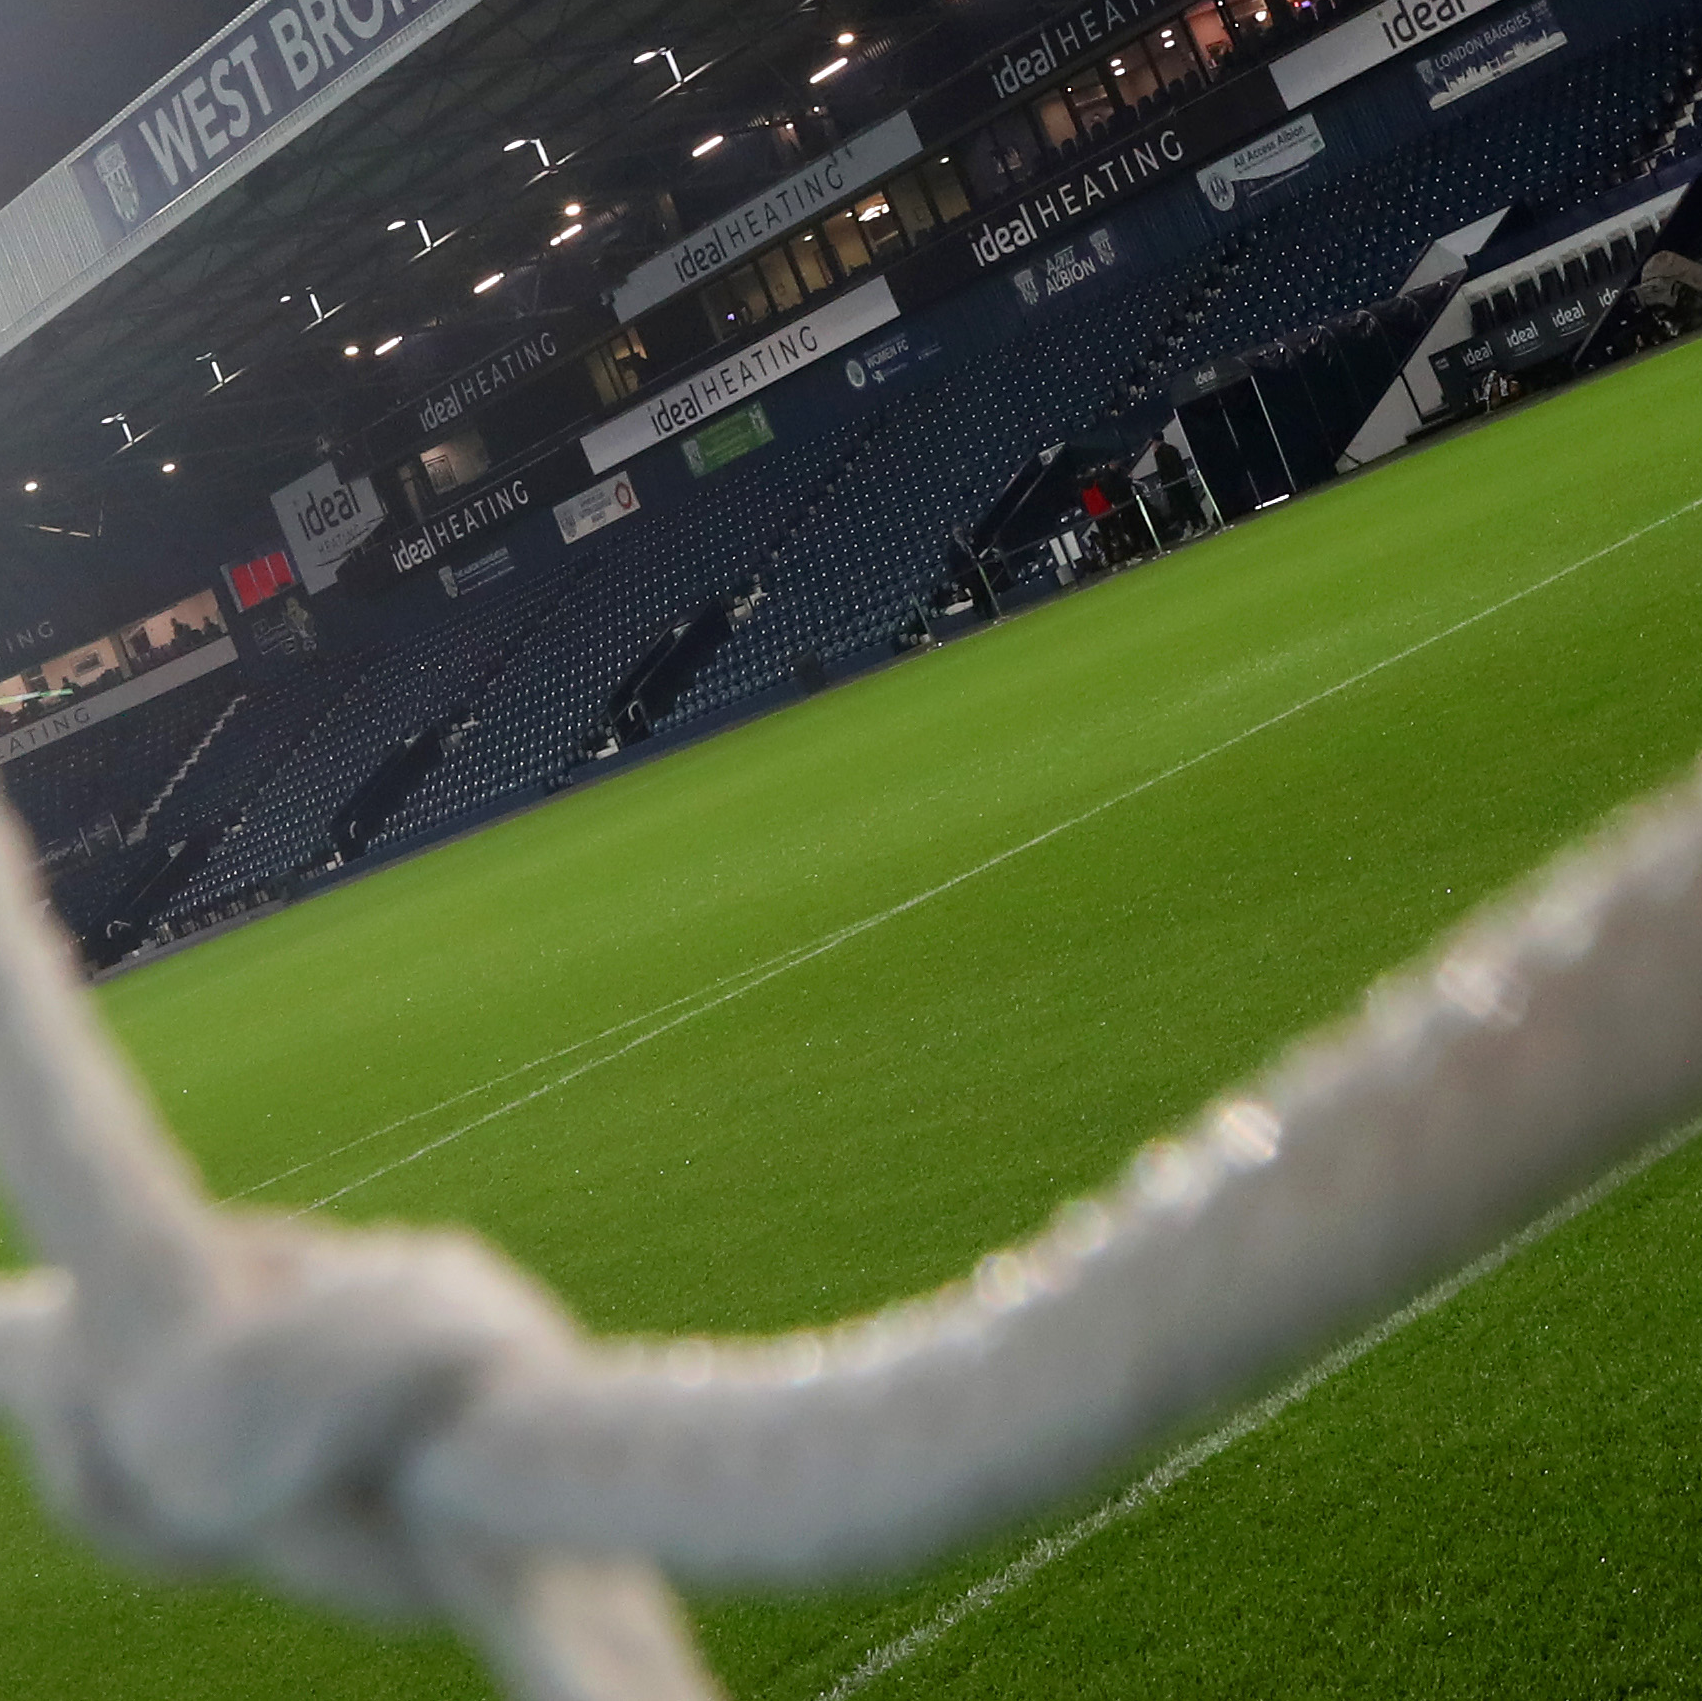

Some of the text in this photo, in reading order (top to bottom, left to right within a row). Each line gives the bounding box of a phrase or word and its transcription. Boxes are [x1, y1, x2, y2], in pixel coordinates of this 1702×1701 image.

[989, 40, 1060, 99] ideal
[1434, 36, 1484, 71] LONDON
[1483, 10, 1532, 45] BAGGIES
[139, 41, 275, 188] WEST
[1233, 155, 1246, 169] All
[1247, 141, 1277, 161] Access
[1277, 125, 1307, 146] Albion
[671, 163, 846, 284] ideal HEATING
[970, 203, 1038, 268] ideal
[1036, 129, 1185, 228] HEATING
[1045, 256, 1097, 296] ALBION
[1505, 320, 1540, 348] ideal
[1552, 300, 1587, 329] ideal
[419, 332, 558, 432] ideal HEATING
[648, 325, 820, 438] ideal HEATING
[864, 345, 898, 369] WOMEN
[896, 339, 909, 353] FC
[1461, 339, 1495, 367] ideal
[295, 483, 362, 542] ideal
[390, 523, 436, 574] ideal
[434, 479, 530, 544] HEATING
